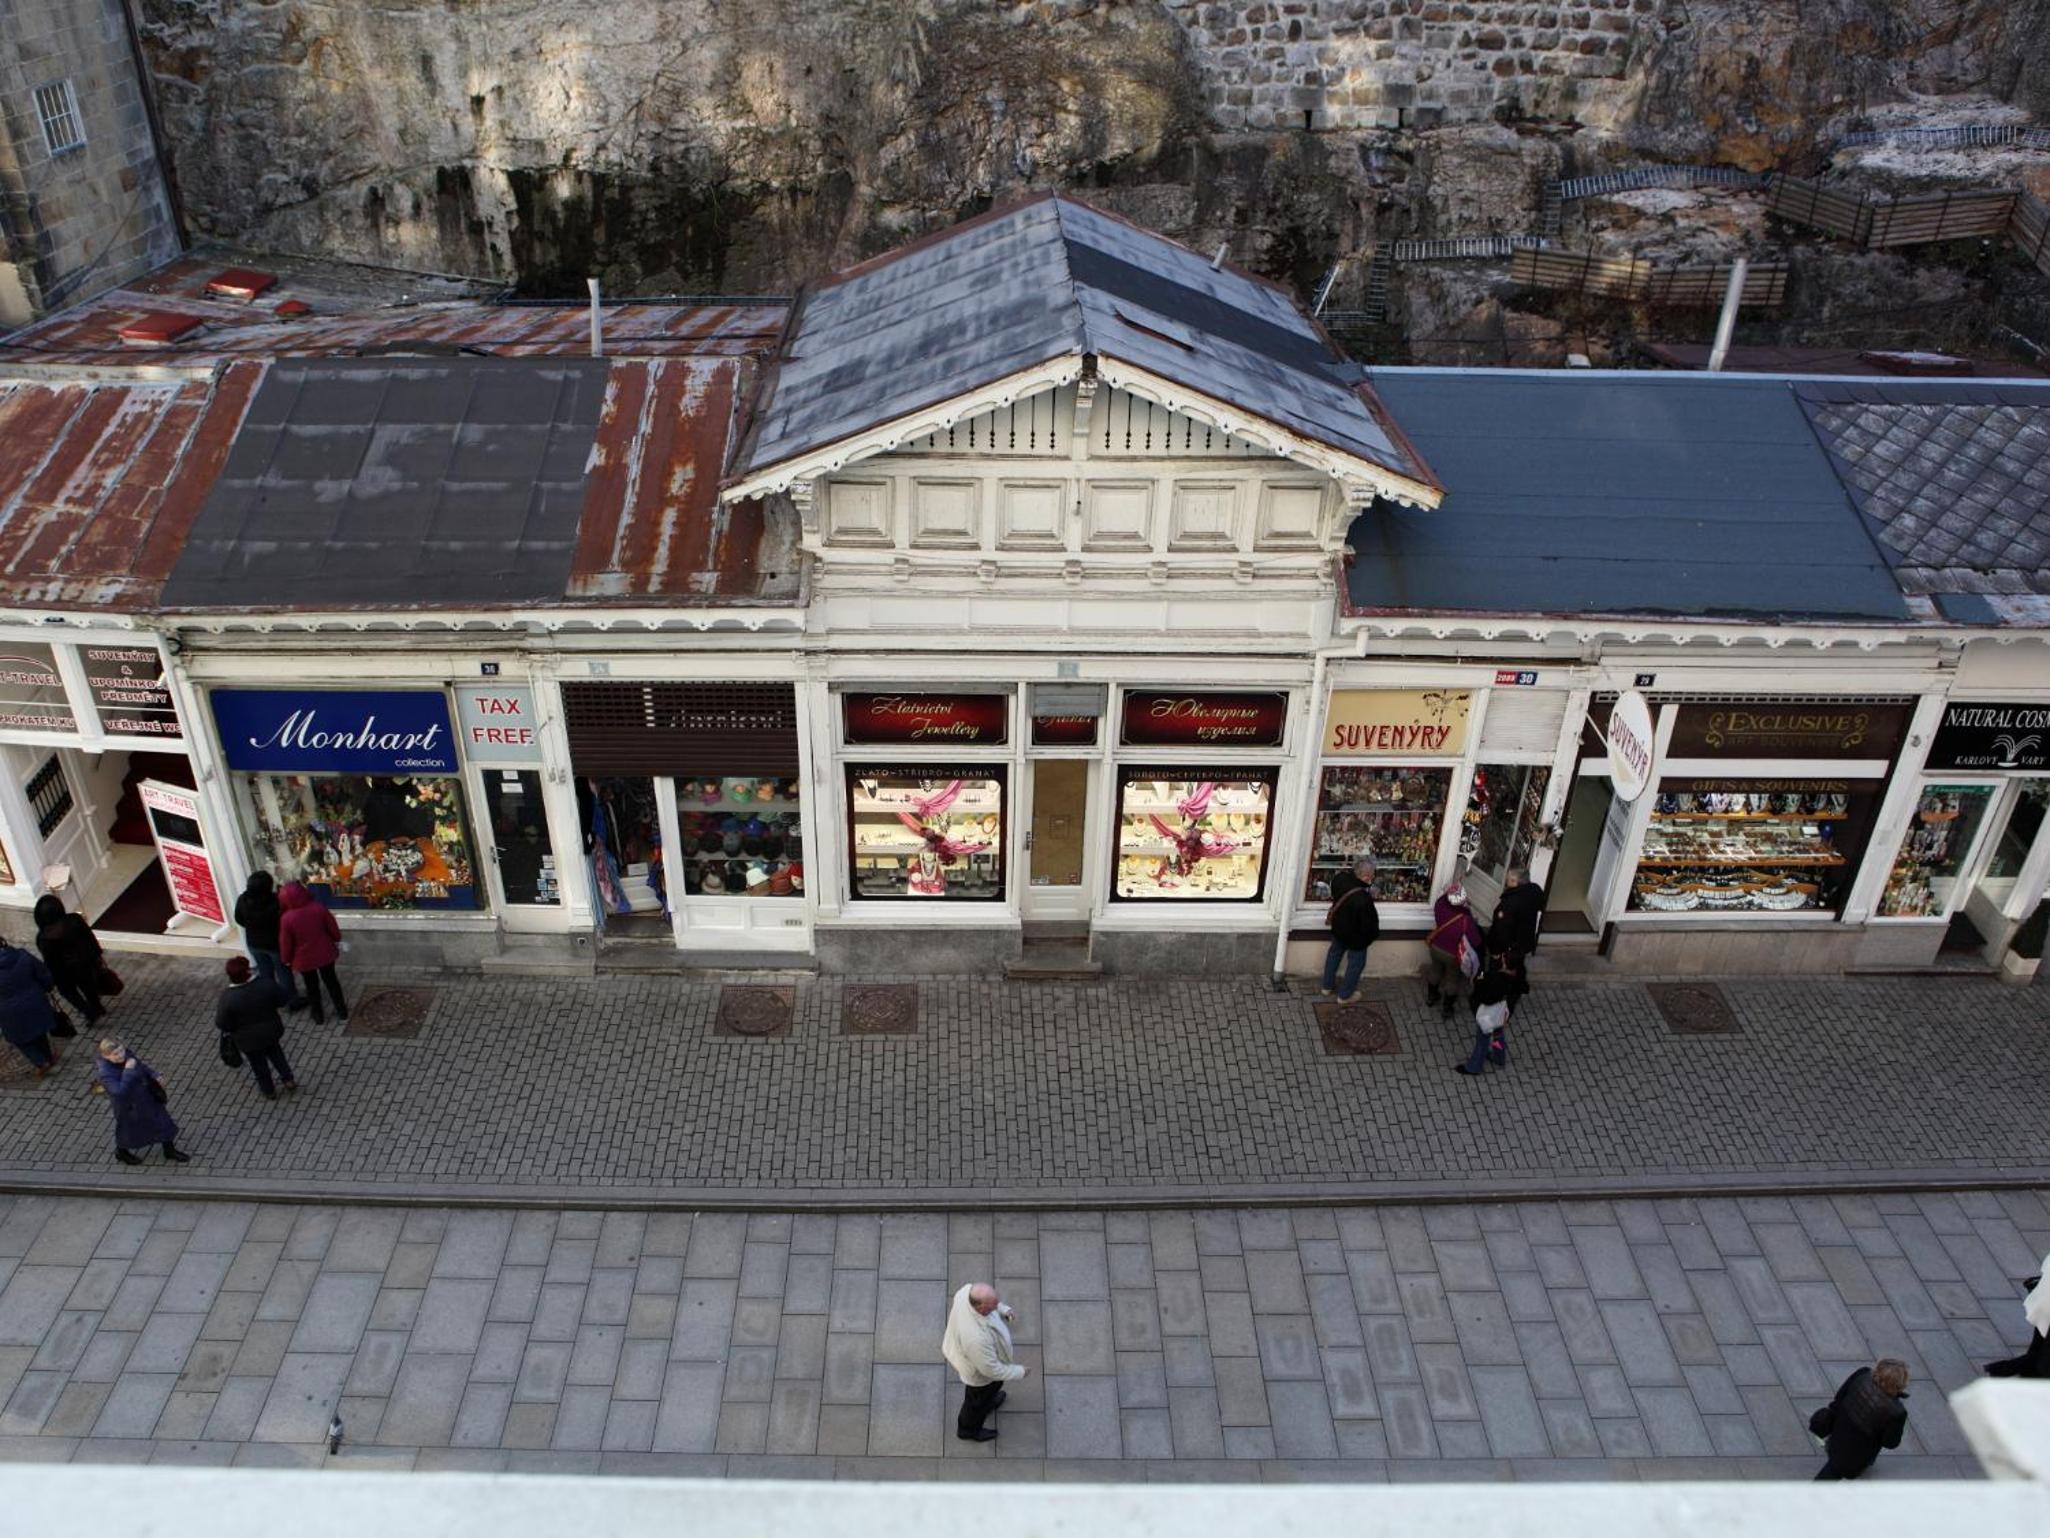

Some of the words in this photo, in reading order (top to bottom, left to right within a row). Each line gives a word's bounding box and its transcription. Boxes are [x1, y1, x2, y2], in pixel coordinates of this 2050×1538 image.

[121, 665, 133, 675] &
[1519, 673, 1534, 684] 30
[475, 698, 521, 715] TAX
[1946, 708, 2013, 727] NATURAL
[249, 709, 444, 750] Monhart
[472, 727, 534, 745] FREE
[911, 717, 980, 739] Jewellery
[1333, 719, 1452, 750] SUVENÝRY
[395, 758, 445, 768] collection
[1955, 755, 1998, 765] KARLOVY
[2021, 756, 2045, 765] VARY
[1754, 780, 1849, 791] SOUVENIRS
